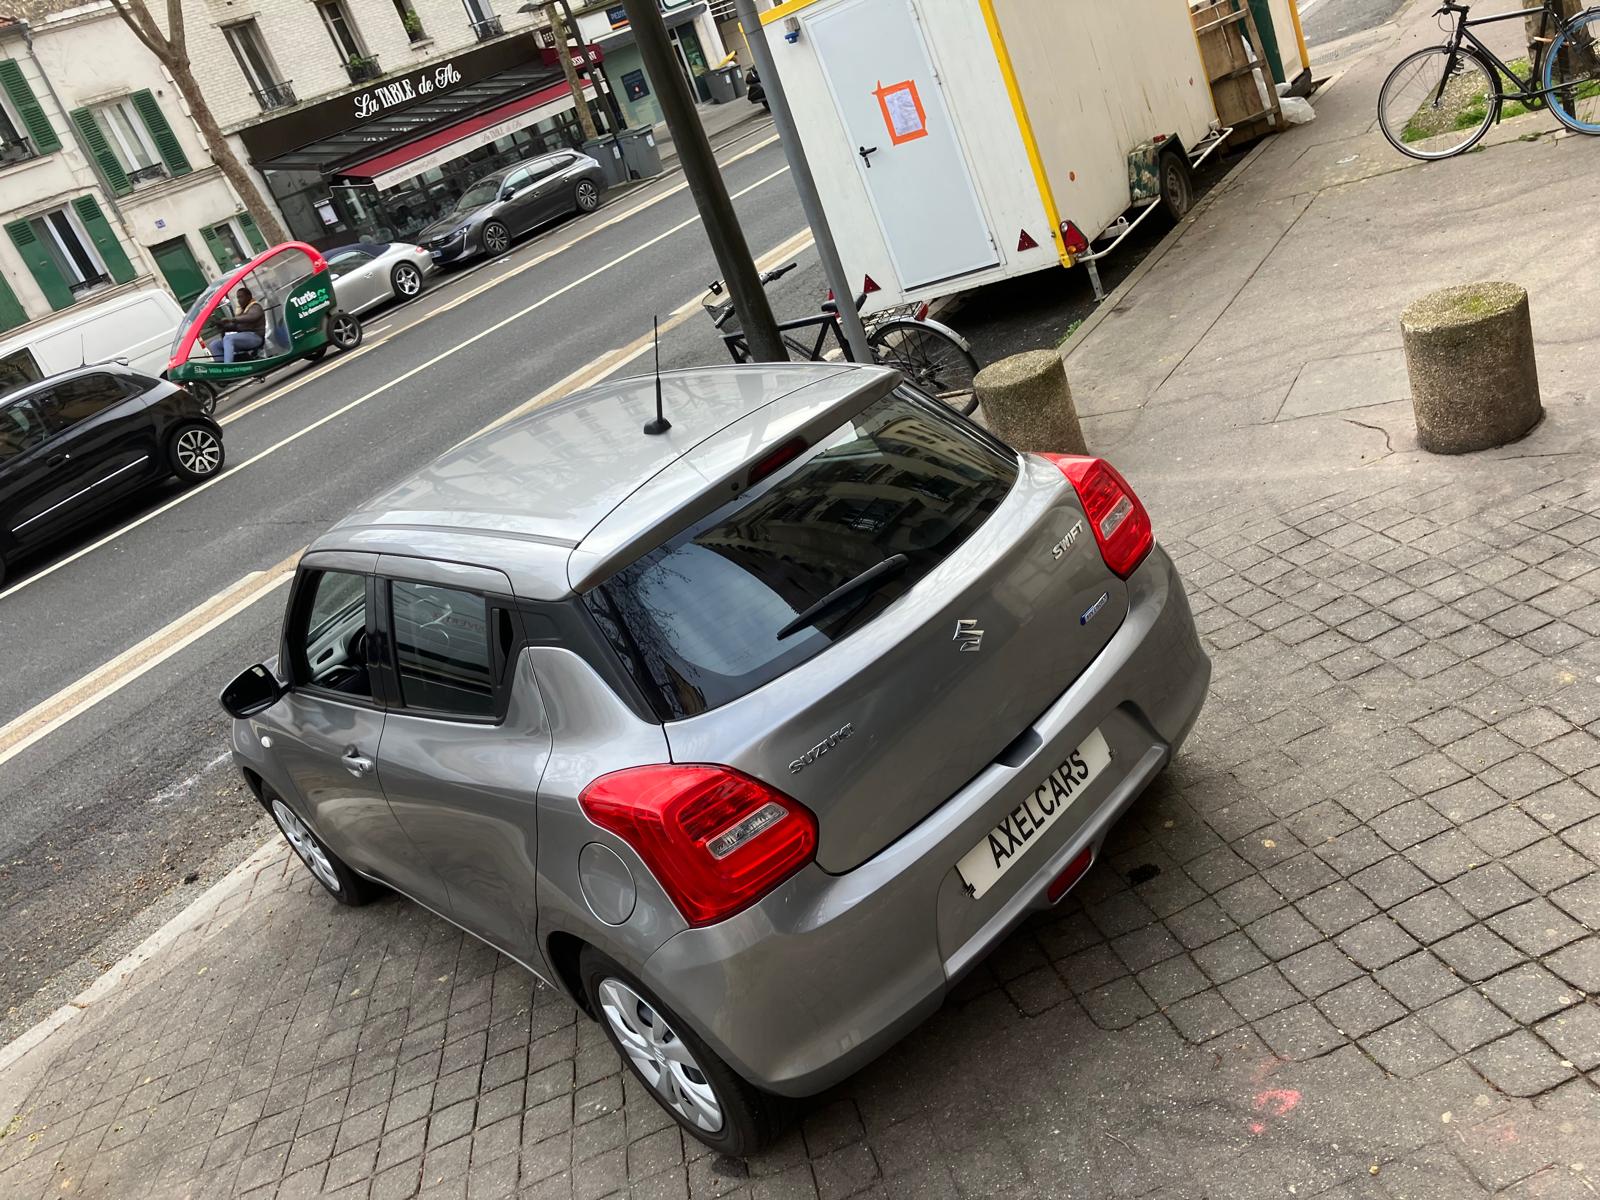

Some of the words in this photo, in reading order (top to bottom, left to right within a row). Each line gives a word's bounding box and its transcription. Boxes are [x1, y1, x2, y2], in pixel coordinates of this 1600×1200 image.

[354, 94, 379, 118] La
[375, 79, 417, 109] TABLE
[418, 75, 434, 95] de
[290, 290, 317, 308] Turtle
[1052, 519, 1084, 560] SWIFT
[788, 722, 856, 775] SUZUKI
[986, 749, 1089, 869] AXELCARS
